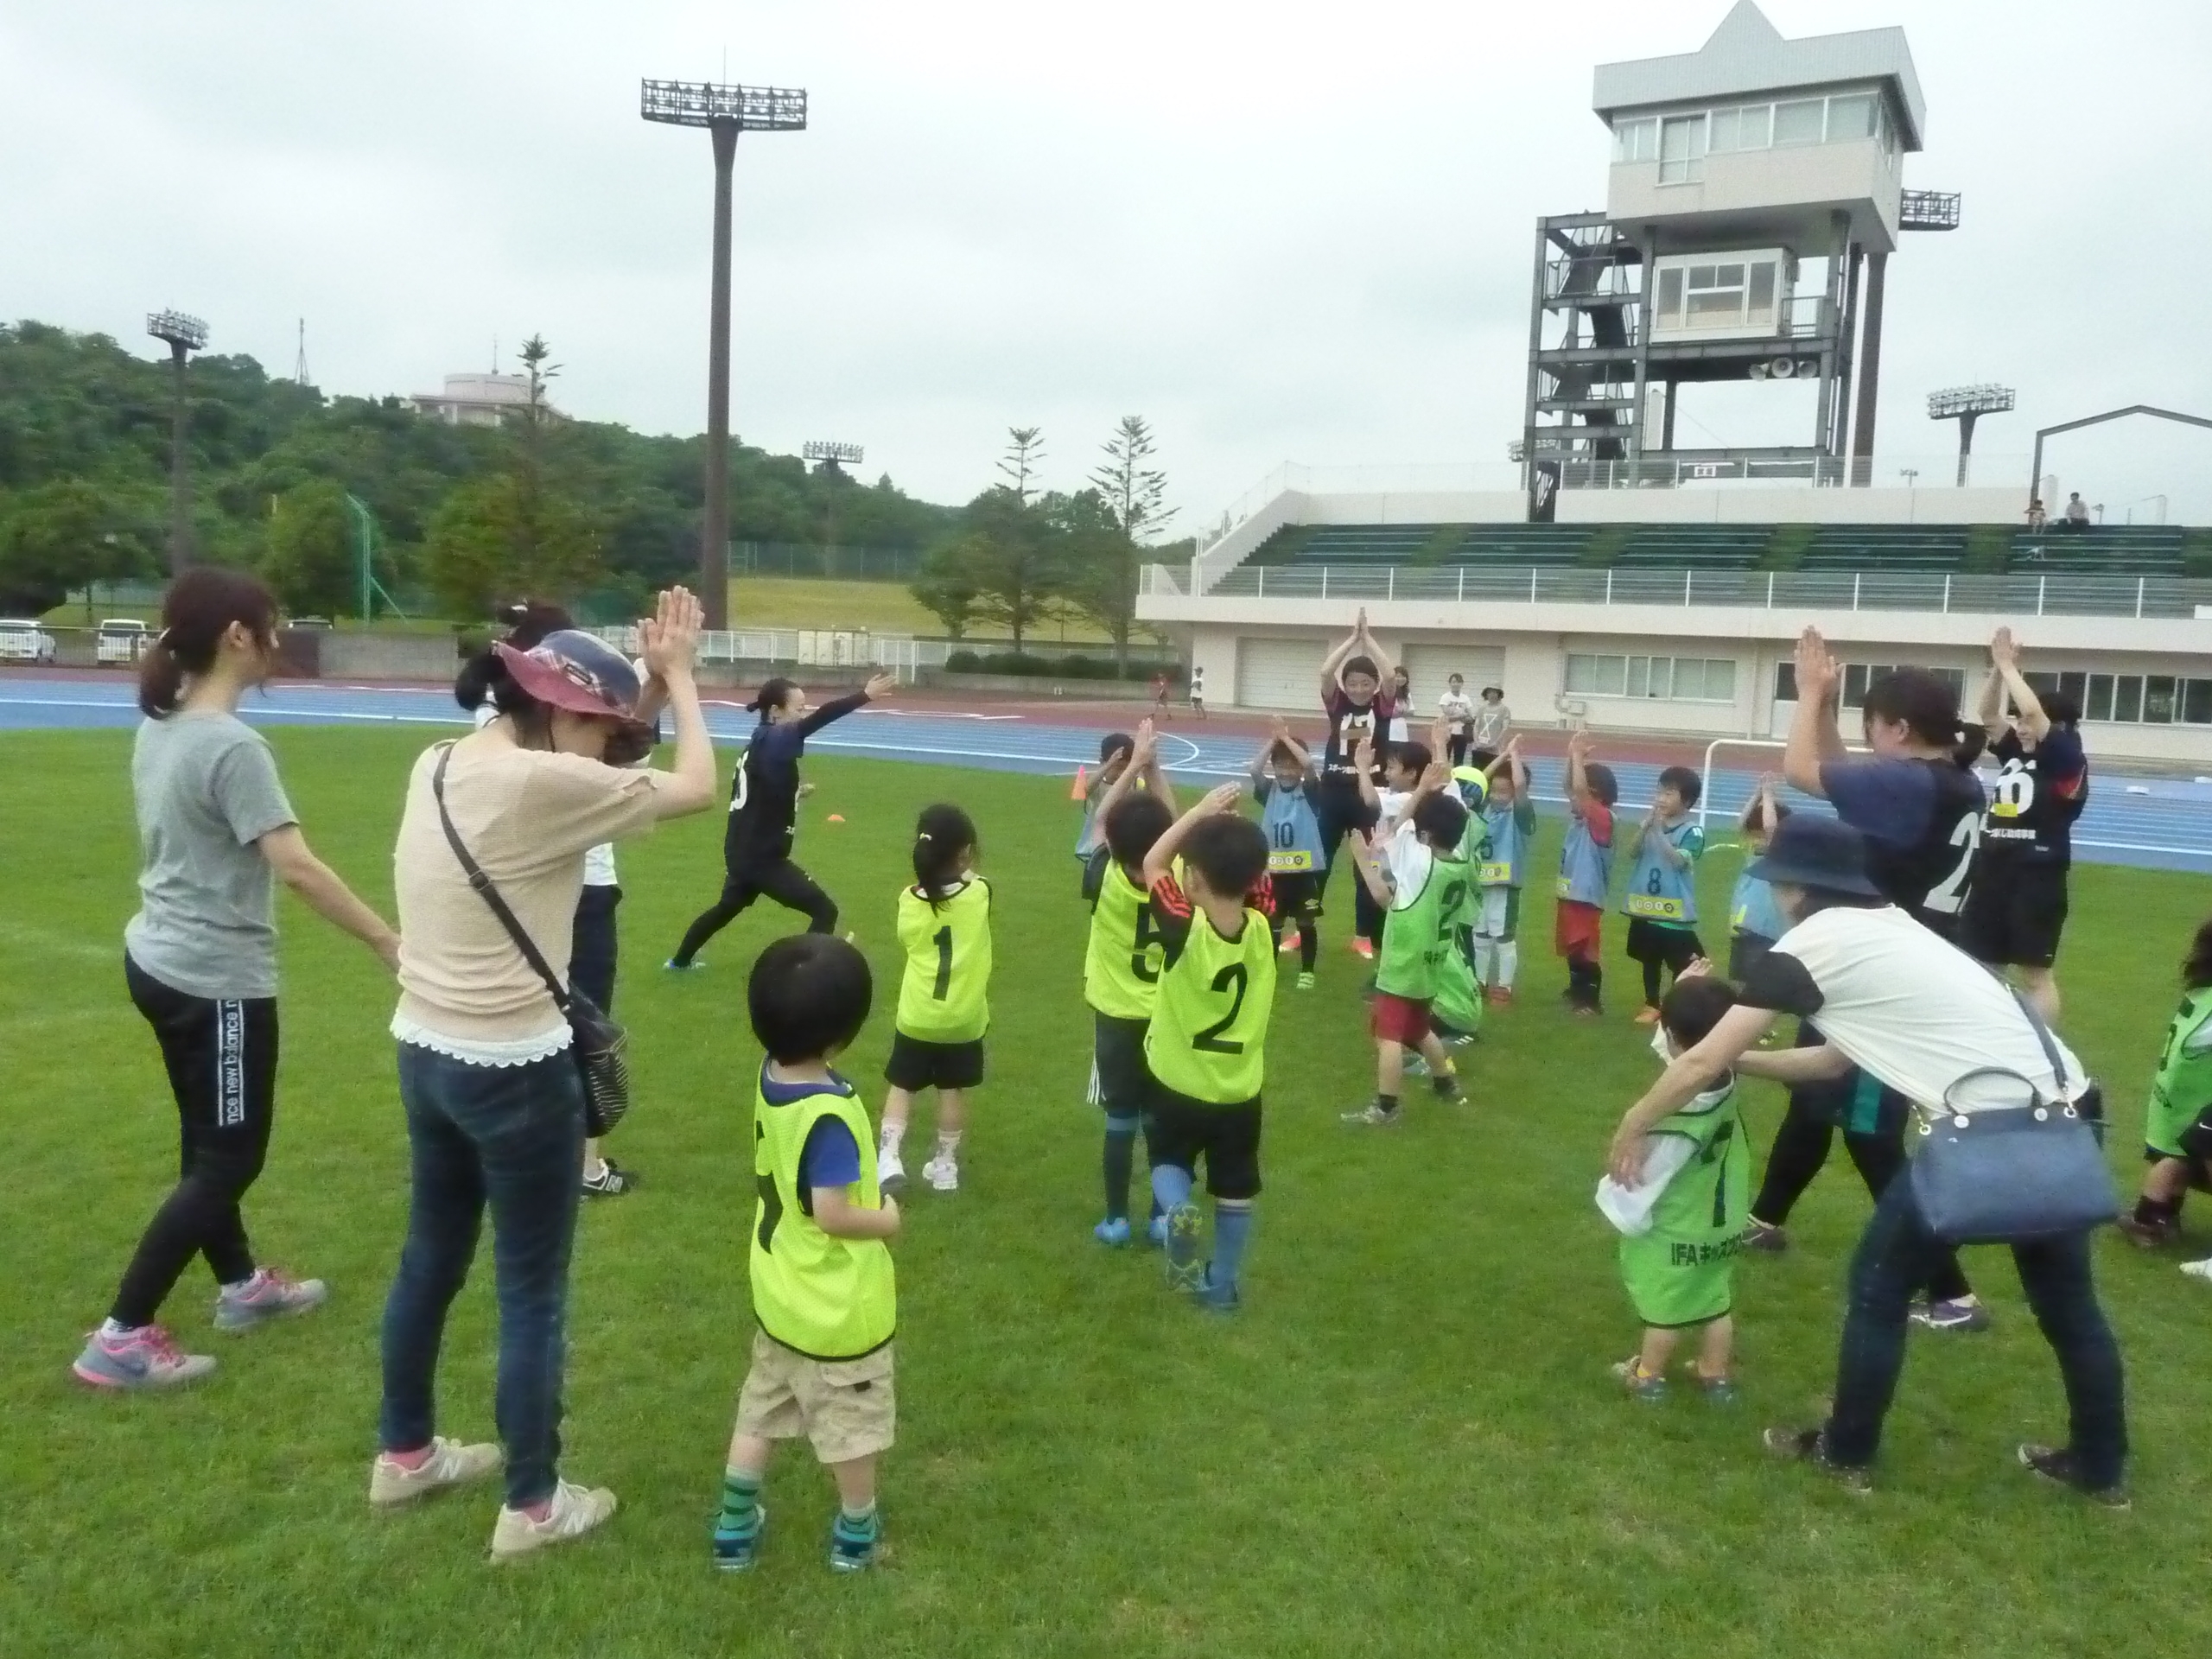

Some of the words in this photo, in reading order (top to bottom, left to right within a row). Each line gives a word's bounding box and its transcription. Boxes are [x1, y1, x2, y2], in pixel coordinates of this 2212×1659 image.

[1274, 823, 1294, 849] 10
[1647, 868, 1662, 894] 8
[1438, 880, 1466, 942] 2
[933, 925, 952, 1001] 1
[1192, 962, 1248, 1055] 2
[224, 1012, 238, 1065] balance
[226, 1067, 238, 1094] new
